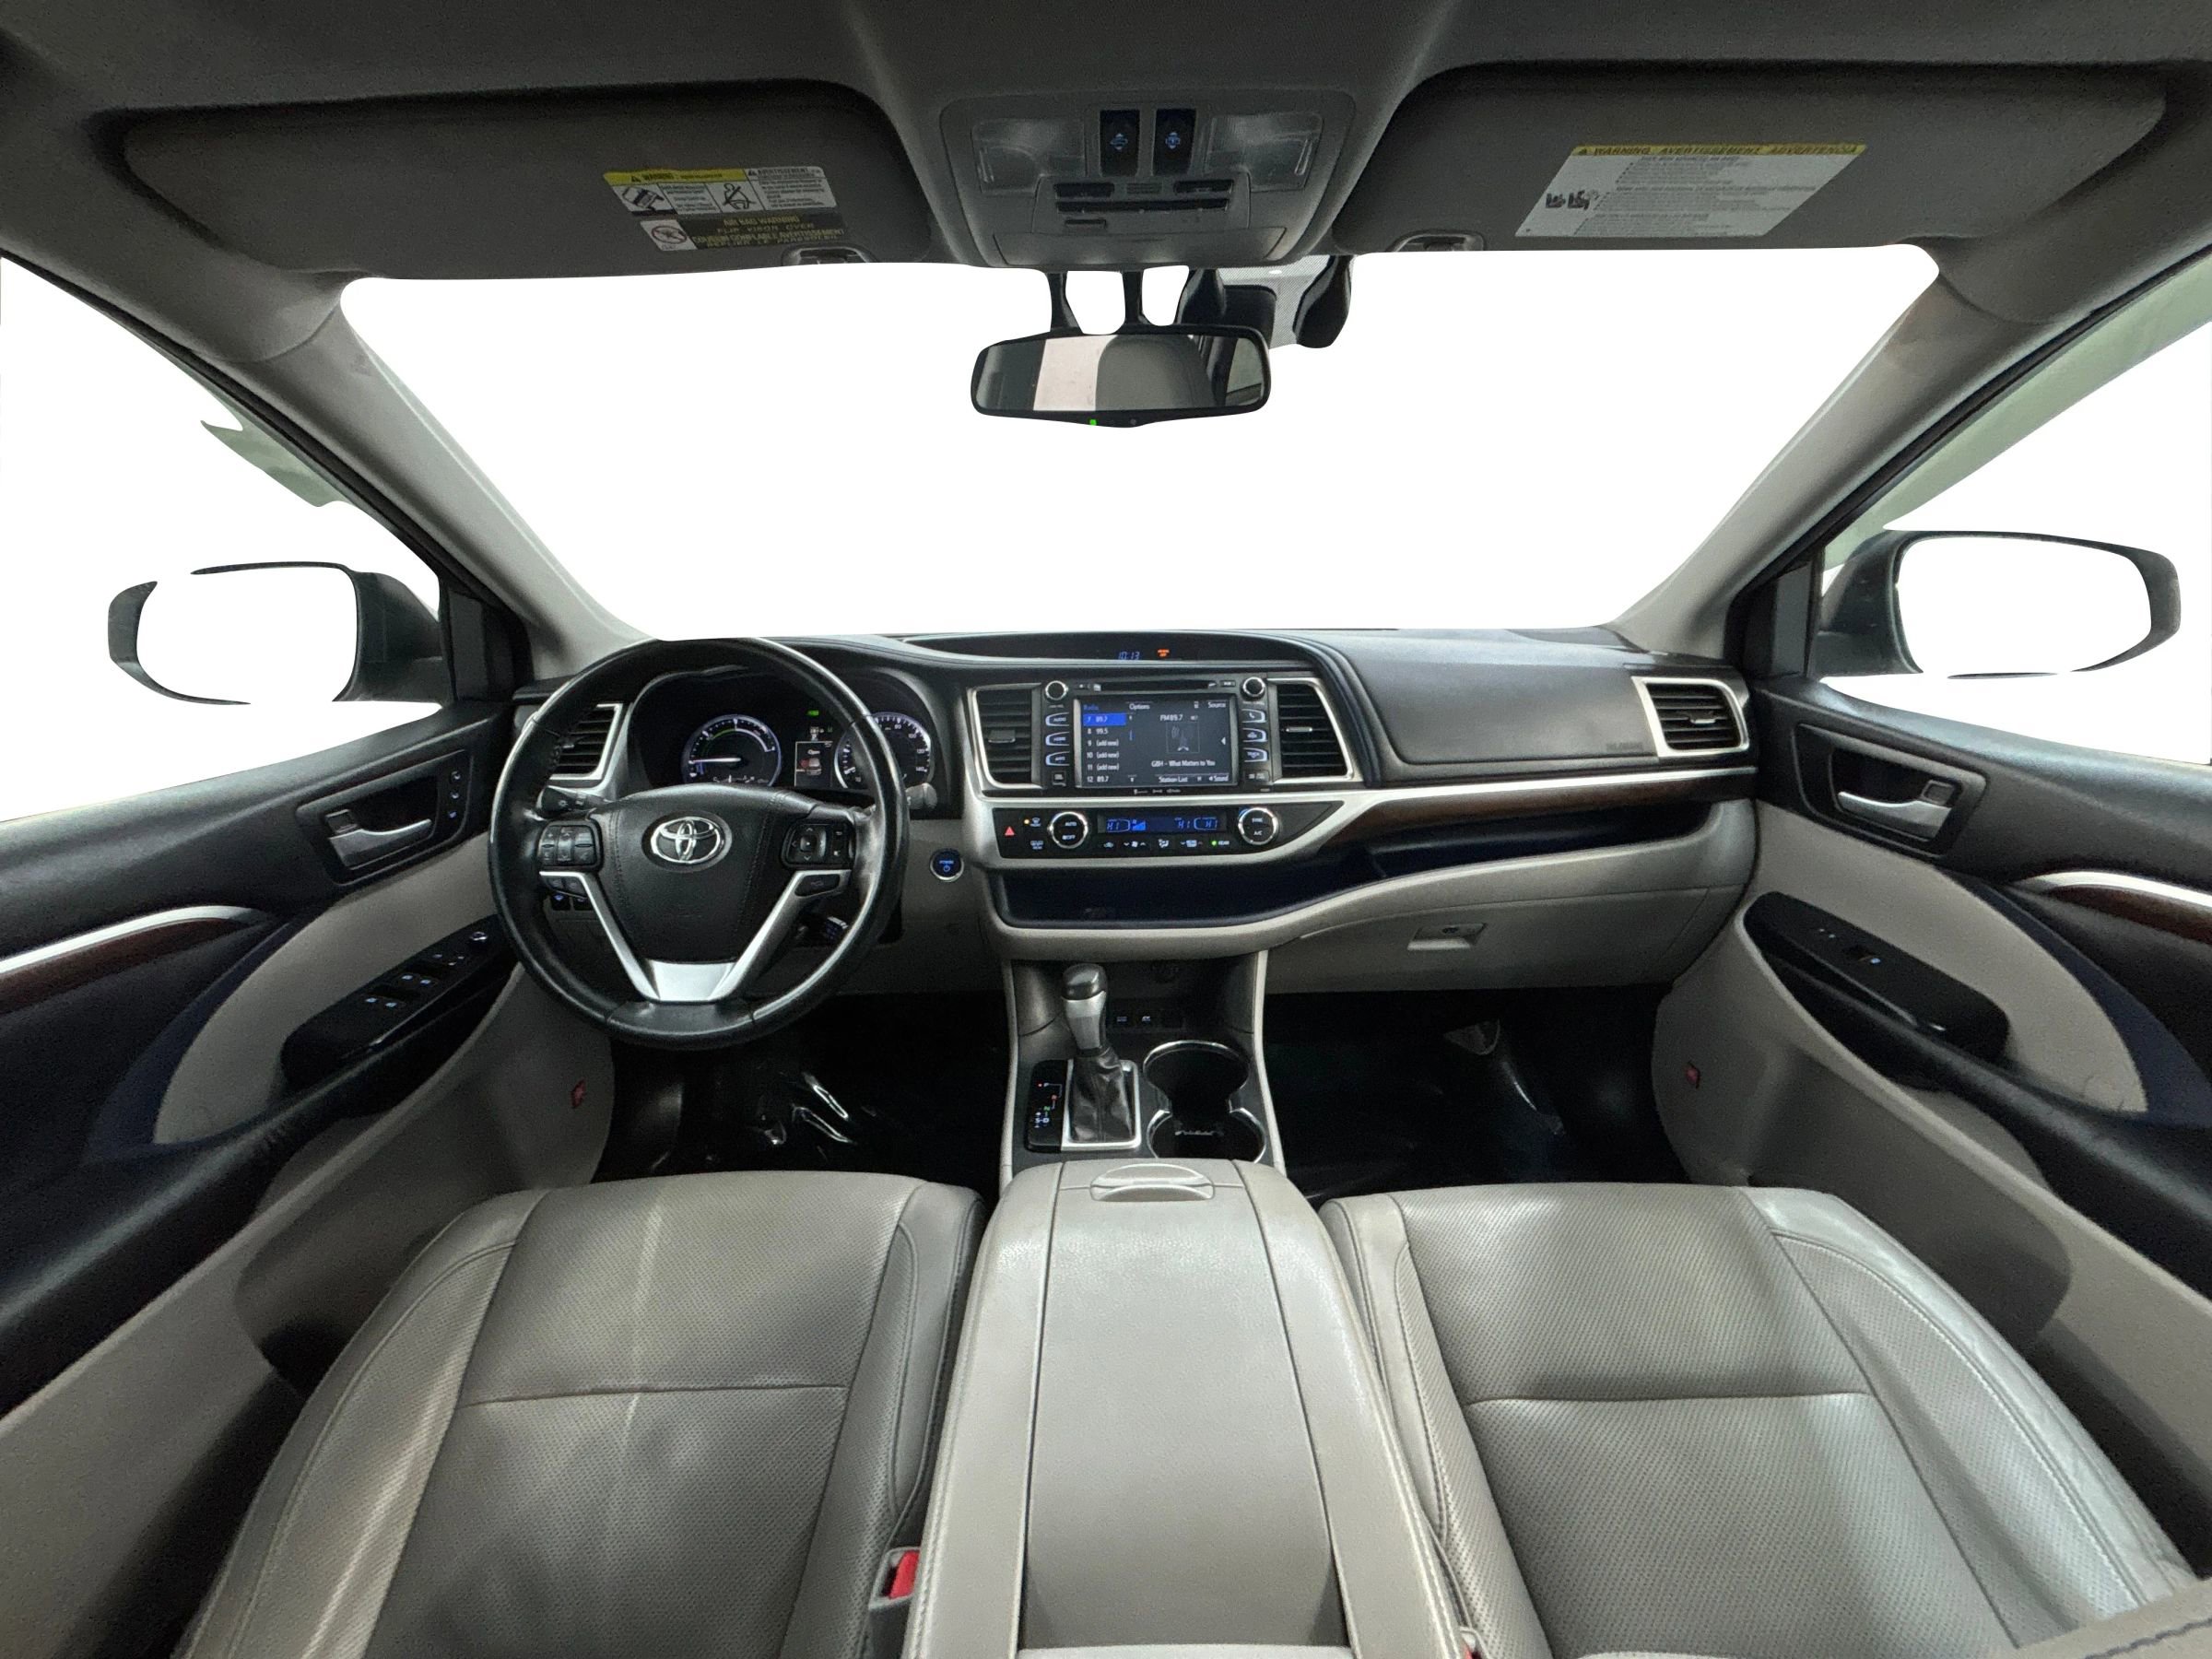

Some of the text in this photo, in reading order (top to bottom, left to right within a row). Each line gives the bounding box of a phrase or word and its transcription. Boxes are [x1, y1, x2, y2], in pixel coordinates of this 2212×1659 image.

[1594, 147, 1651, 156] WARNING
[759, 216, 800, 224] WARNING
[1129, 703, 1151, 712] Options
